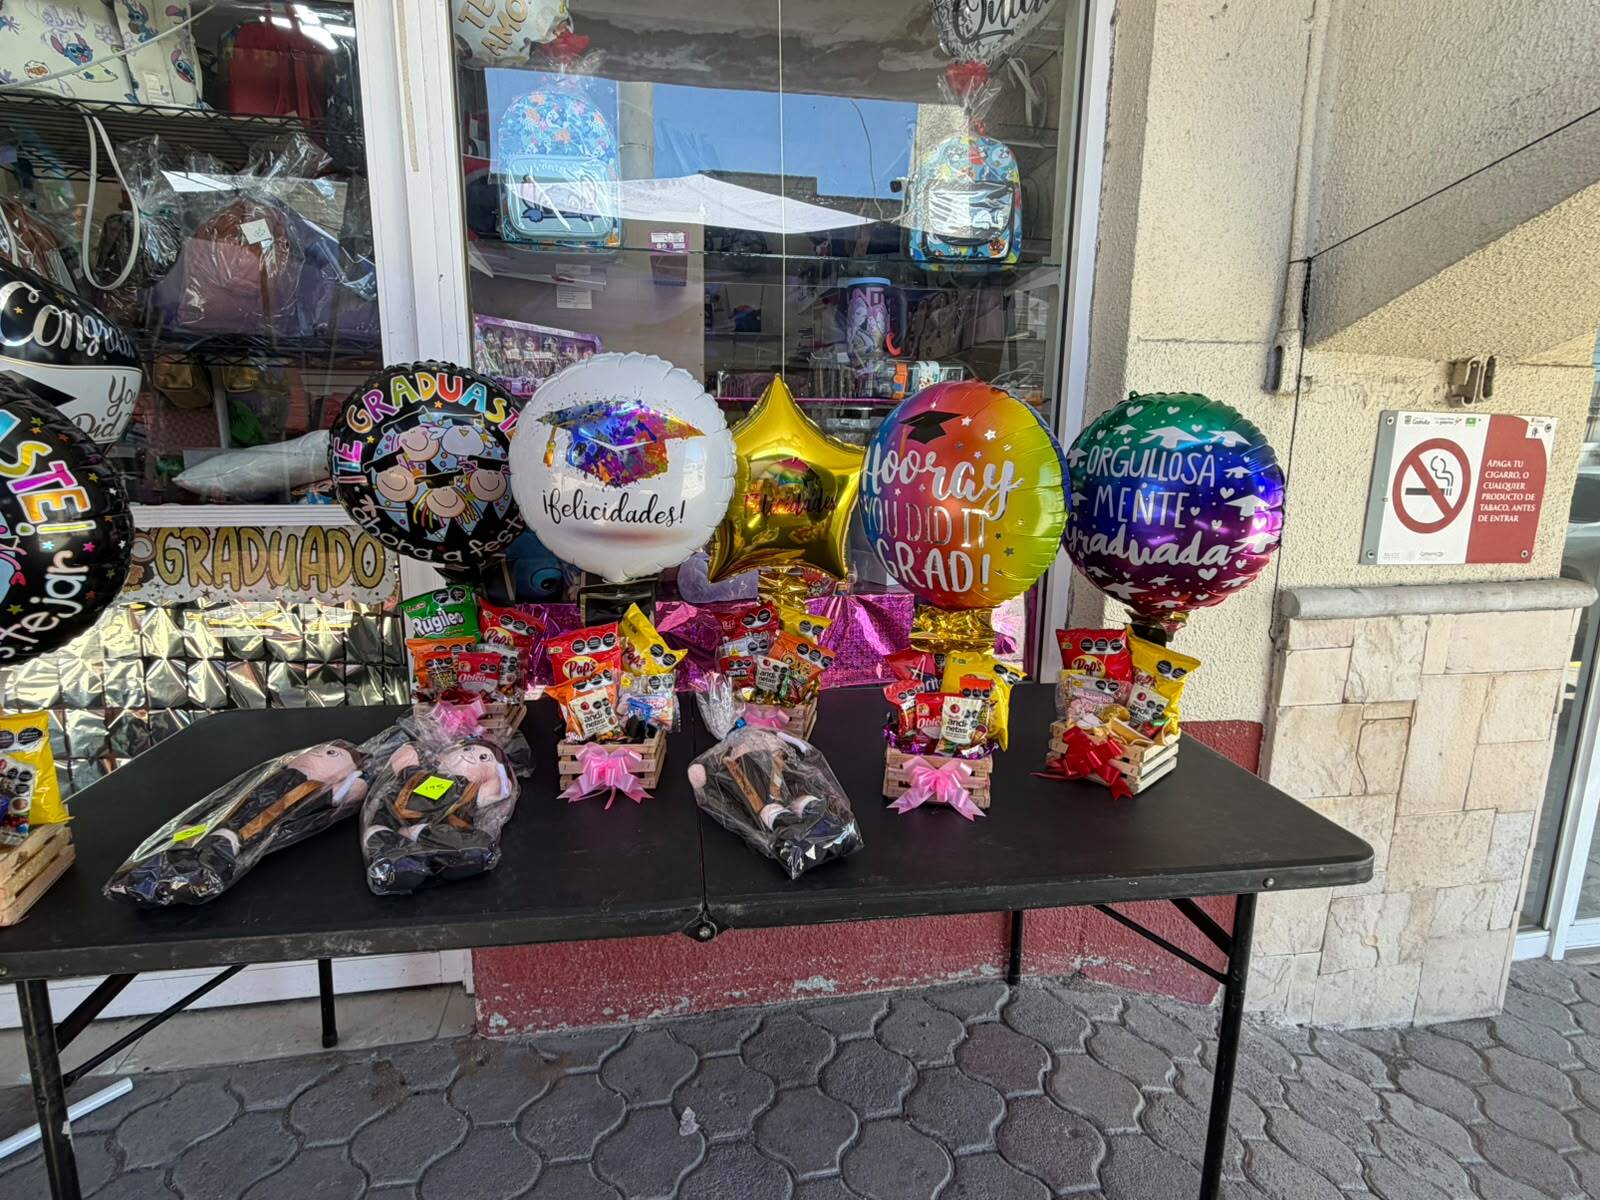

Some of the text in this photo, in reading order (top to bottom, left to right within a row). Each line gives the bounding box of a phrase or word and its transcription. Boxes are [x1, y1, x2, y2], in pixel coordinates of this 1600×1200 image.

[106, 374, 137, 417] Yo
[346, 372, 521, 441] GRADUAST
[860, 440, 1024, 521] Hooray
[1487, 459, 1524, 468] APAGA TU
[1522, 471, 1530, 479] O
[1093, 484, 1190, 529] MENTE
[1481, 493, 1536, 501] PRODUCTO DE
[1482, 481, 1526, 491] CUALQUIER
[862, 495, 898, 538] YOU
[905, 503, 953, 545] DID
[1478, 514, 1519, 522] DE ENTRAR
[1511, 504, 1536, 512] ANTES
[351, 506, 433, 560] ahora
[155, 526, 387, 592] GRADUADO
[876, 538, 992, 593] GRAD!
[916, 718, 941, 731] Oble
